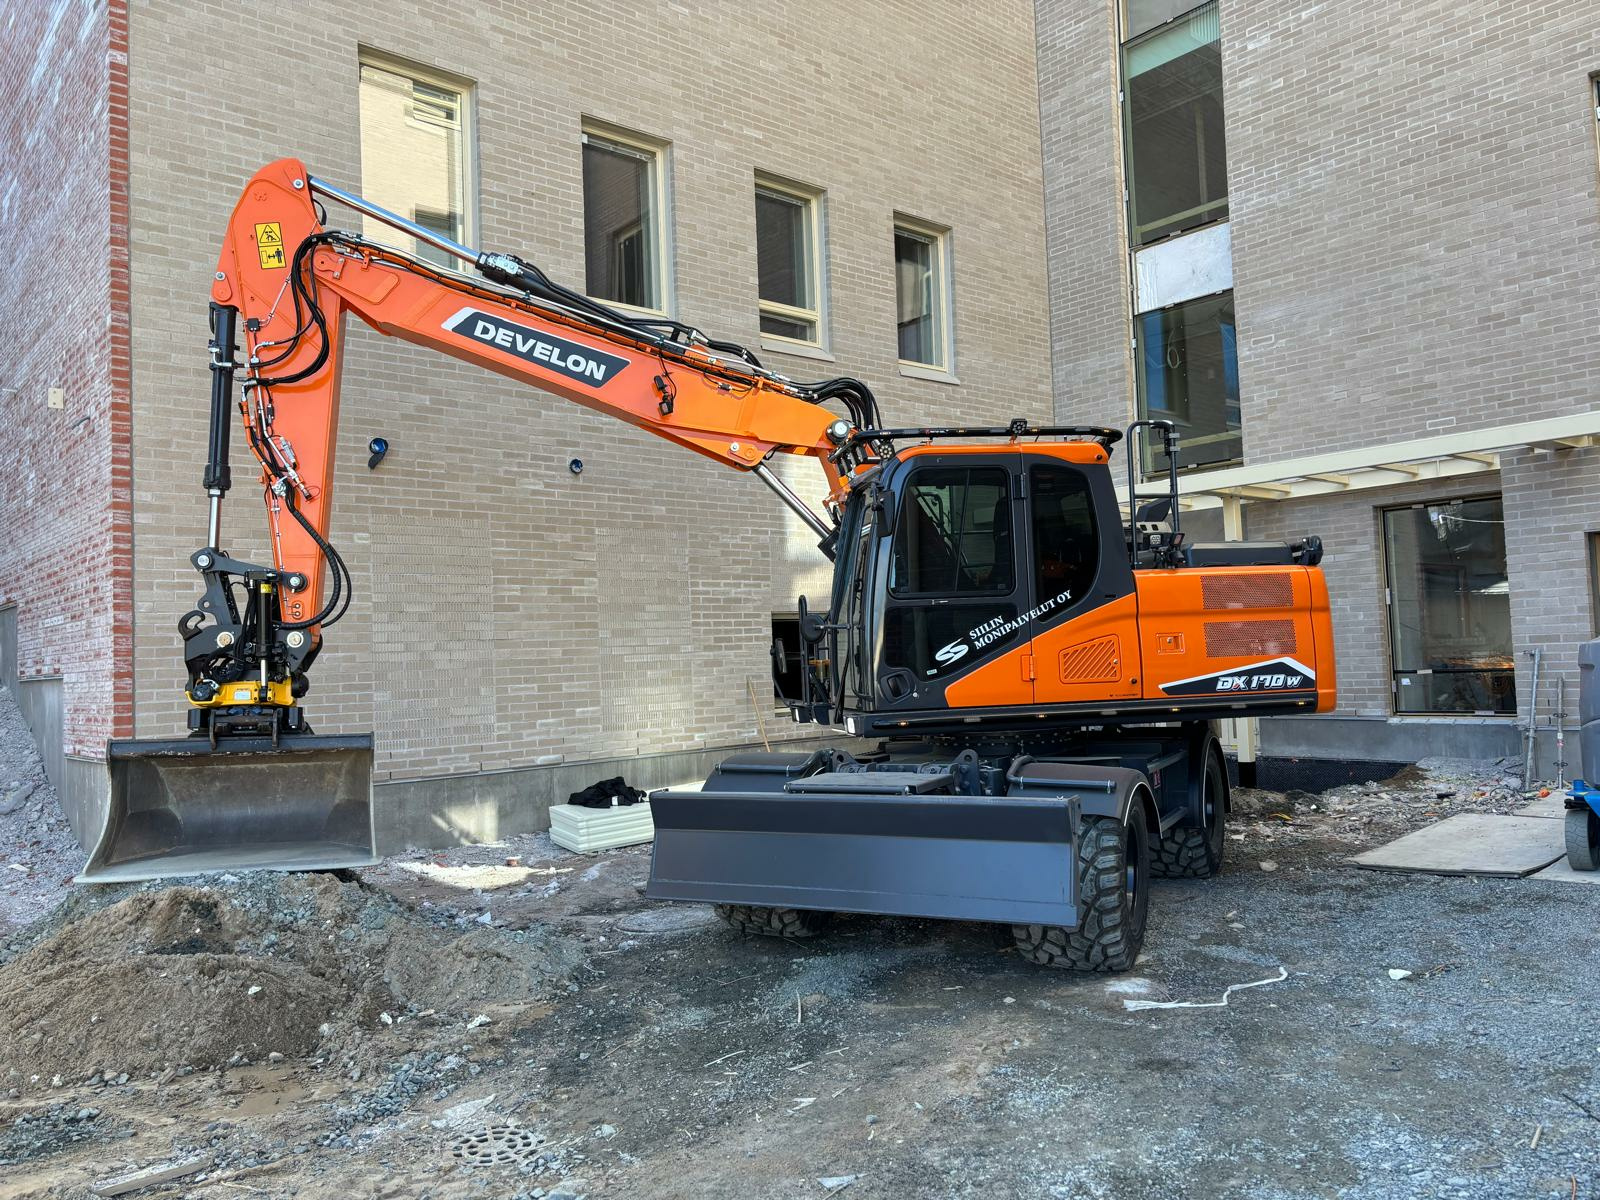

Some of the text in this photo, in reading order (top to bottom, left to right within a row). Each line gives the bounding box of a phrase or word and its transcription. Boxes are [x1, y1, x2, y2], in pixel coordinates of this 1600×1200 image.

[473, 319, 607, 381] DEVELON
[969, 615, 1005, 640] SIILIN
[973, 589, 1073, 650] MONIPALVELUT OY
